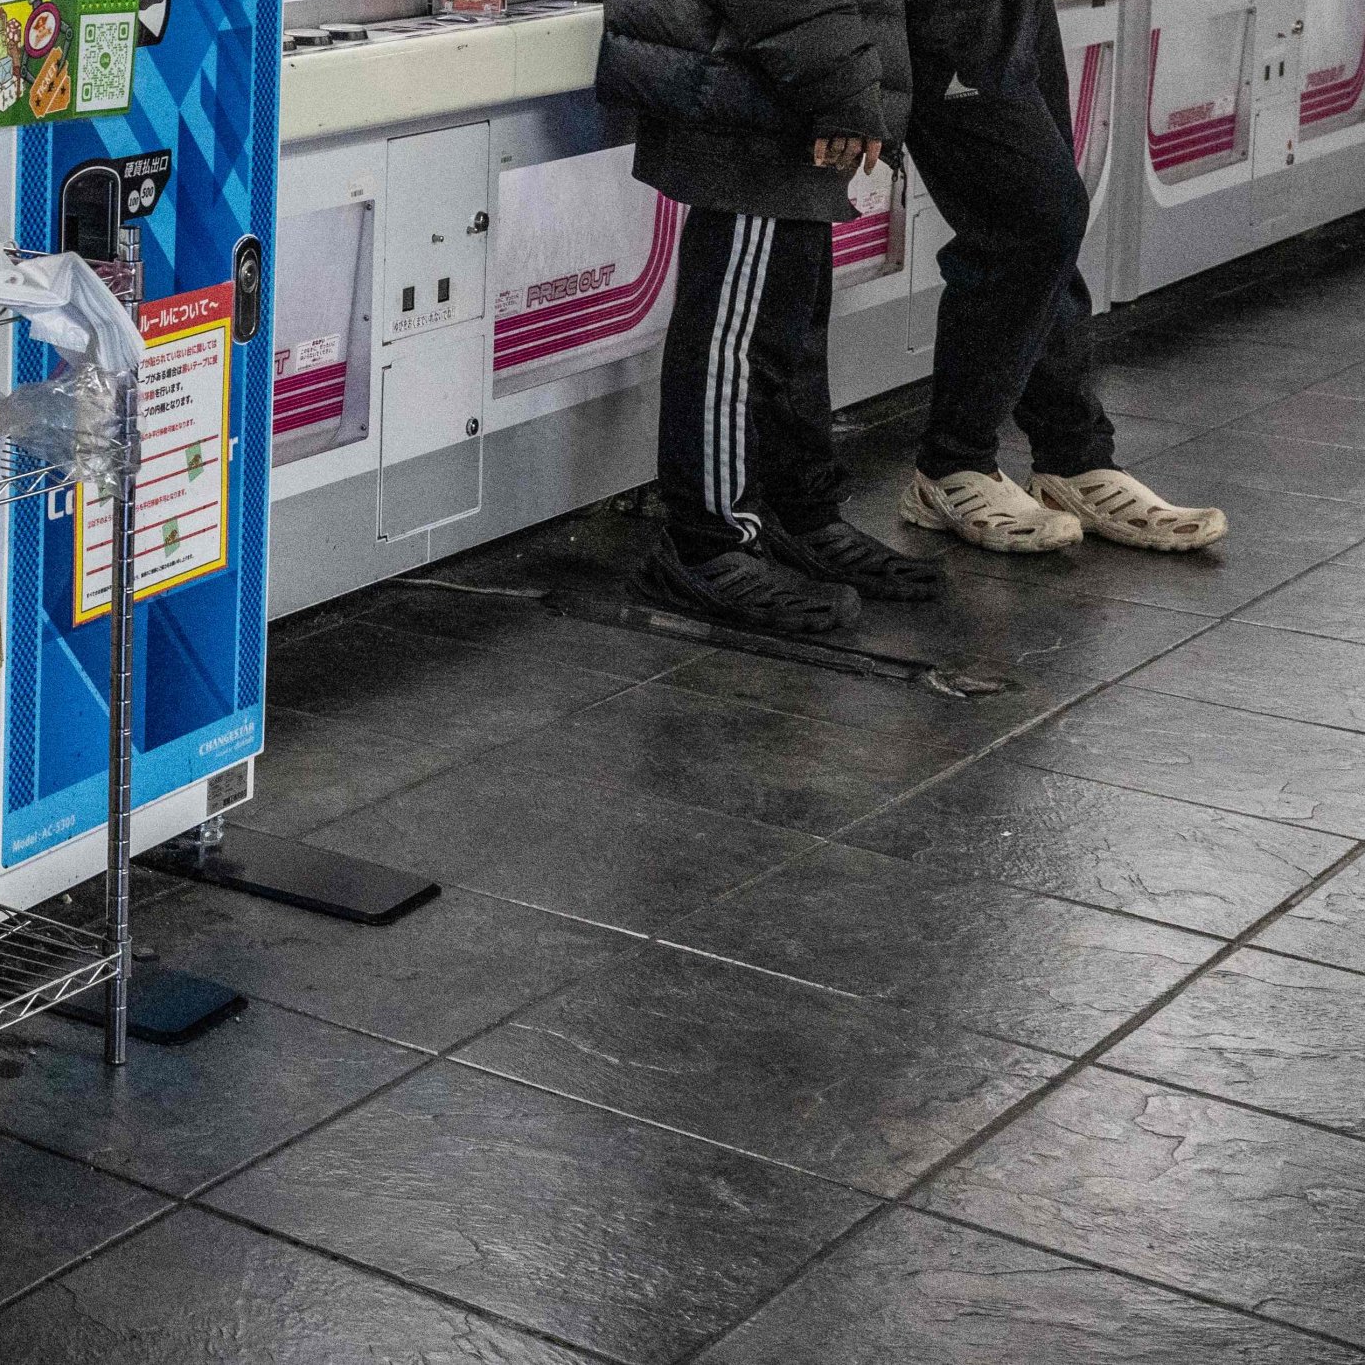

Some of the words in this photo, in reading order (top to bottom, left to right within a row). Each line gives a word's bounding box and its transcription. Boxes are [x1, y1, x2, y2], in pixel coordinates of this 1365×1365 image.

[35, 63, 59, 98] TICKET
[140, 184, 155, 200] 500
[525, 271, 580, 309] PRIZE
[579, 264, 616, 291] OUT
[198, 721, 256, 756] CHANGESTAR
